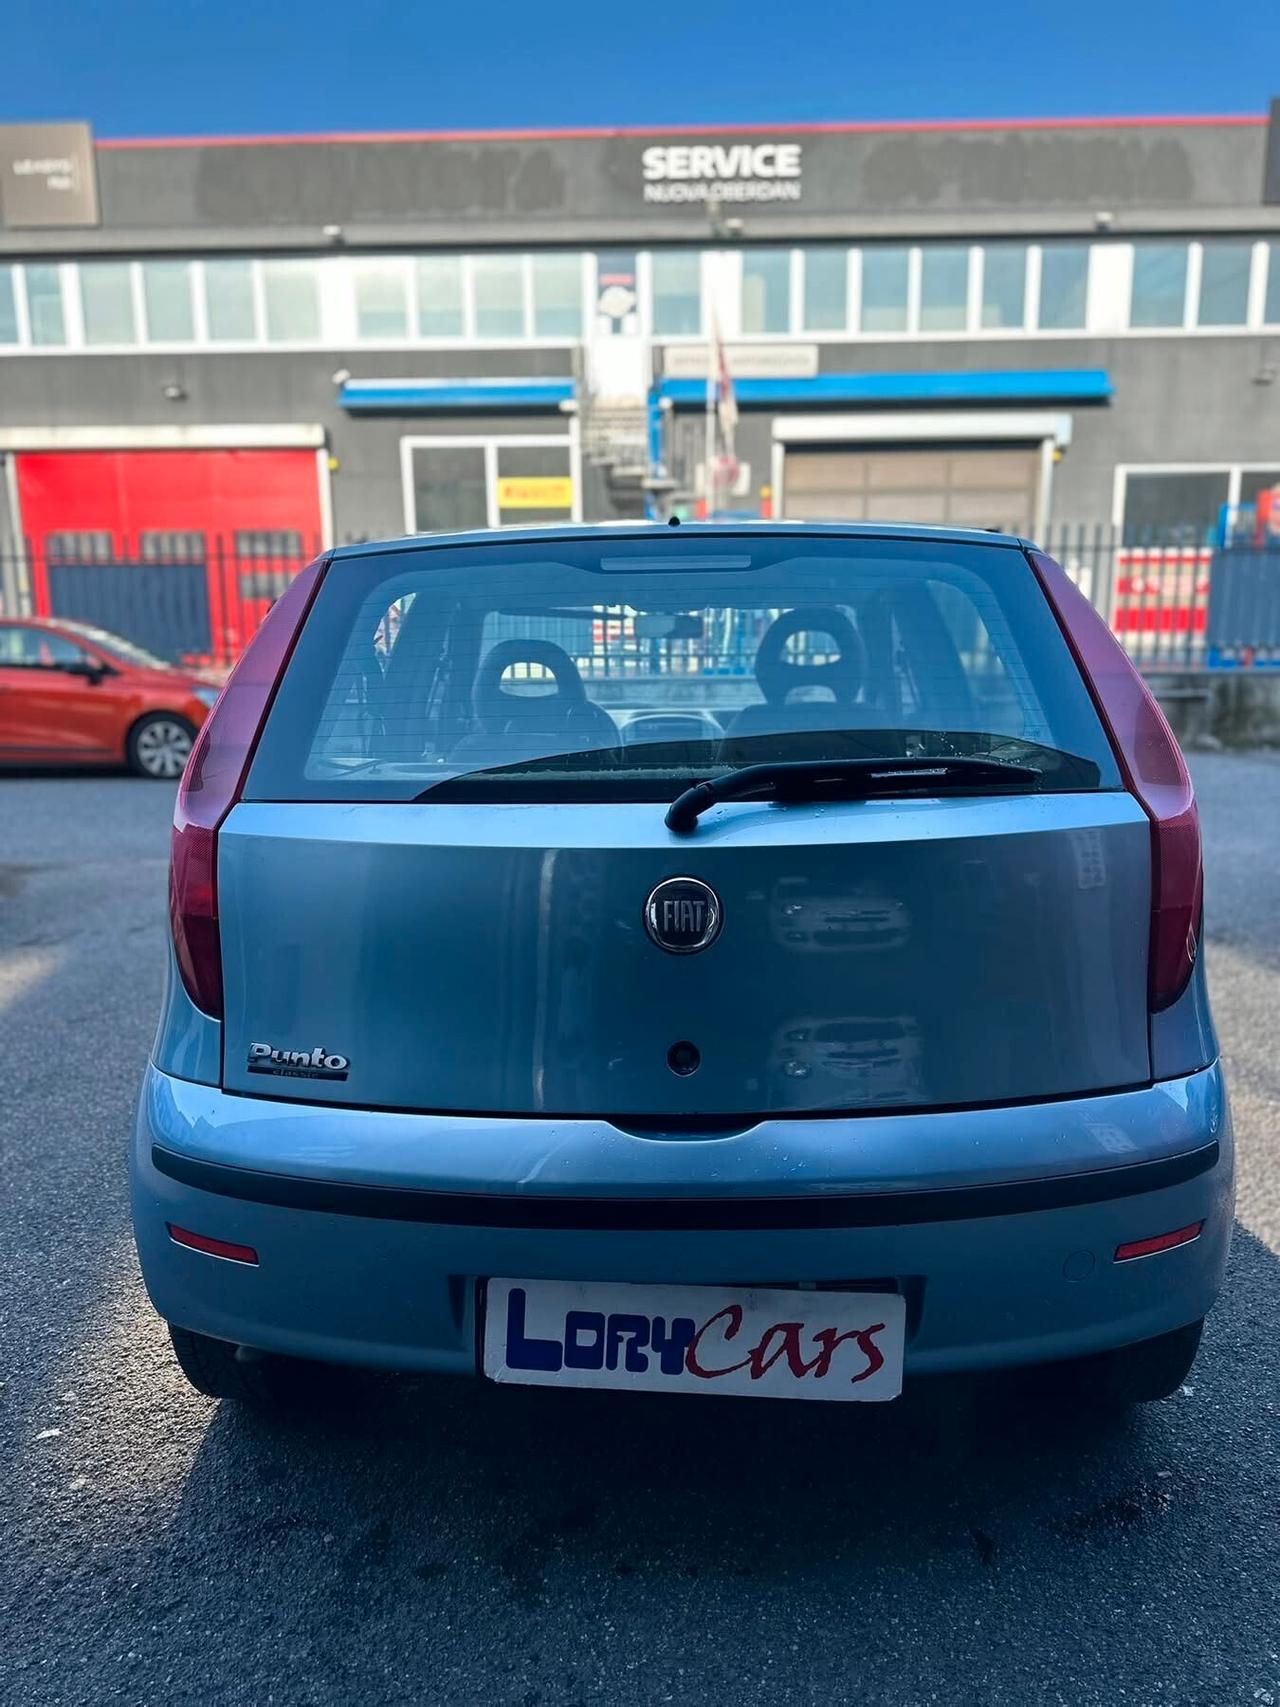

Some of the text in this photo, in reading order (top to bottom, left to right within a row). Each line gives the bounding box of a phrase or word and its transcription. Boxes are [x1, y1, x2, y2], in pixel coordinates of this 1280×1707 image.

[642, 144, 802, 180] SERVICE
[663, 900, 705, 932] FIAT
[248, 1042, 348, 1070] Punto
[272, 1069, 319, 1079] classic
